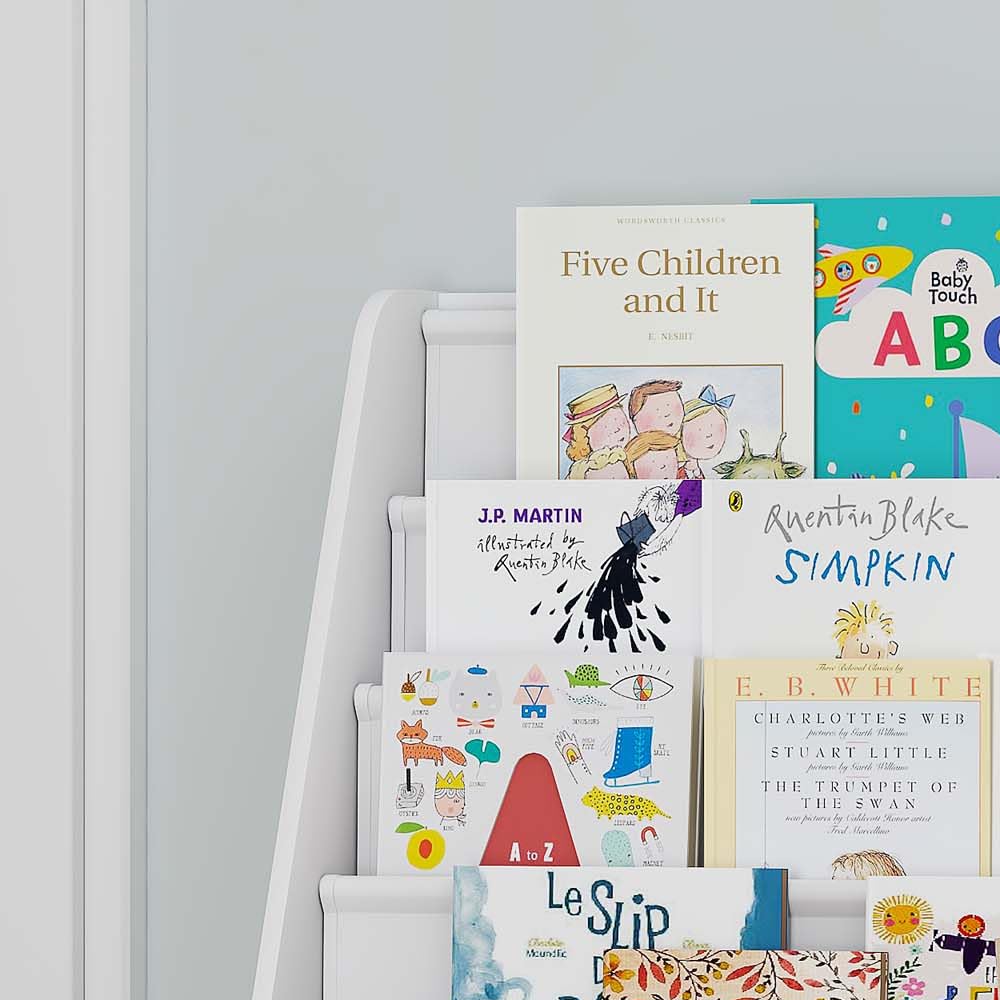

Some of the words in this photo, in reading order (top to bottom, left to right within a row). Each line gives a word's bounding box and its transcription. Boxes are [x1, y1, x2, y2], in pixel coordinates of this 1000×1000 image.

[616, 217, 681, 225] WORDSWORTH
[684, 216, 728, 224] CLASSICS
[560, 250, 629, 278] Five
[637, 248, 782, 277] Children
[931, 272, 973, 290] Baby
[623, 286, 687, 314] and
[695, 287, 720, 313] It
[928, 289, 978, 305] Touch
[661, 332, 695, 342] NESBIT
[477, 508, 506, 524] J.P.
[513, 508, 583, 524] MARTIN
[764, 494, 873, 543] Quentin
[868, 496, 969, 541] Blake
[477, 531, 554, 553] illustrated
[562, 529, 585, 549] by
[493, 554, 548, 583] Quentin
[541, 551, 593, 576] Blake
[775, 548, 956, 587] SIMPKIN
[735, 676, 764, 697] E.
[787, 676, 817, 697] B.
[834, 676, 983, 698] WHITE
[753, 712, 908, 726] CHARLOTTE'S
[921, 712, 967, 726] WEB
[806, 729, 837, 739] pictures
[838, 728, 849, 739] by
[877, 728, 909, 737] Williams
[771, 746, 857, 760] STUART
[869, 746, 948, 760] LITTLE
[806, 762, 837, 773] pictures
[838, 761, 849, 773] by
[877, 761, 910, 771] Williams
[761, 780, 802, 794] THE
[815, 780, 918, 794] TRUMPET
[930, 780, 959, 794] OF
[800, 797, 842, 810] THE
[855, 797, 918, 810] SWAN
[508, 842, 521, 863] A
[526, 849, 538, 861] to
[543, 842, 555, 862] Z
[547, 871, 583, 916] Le
